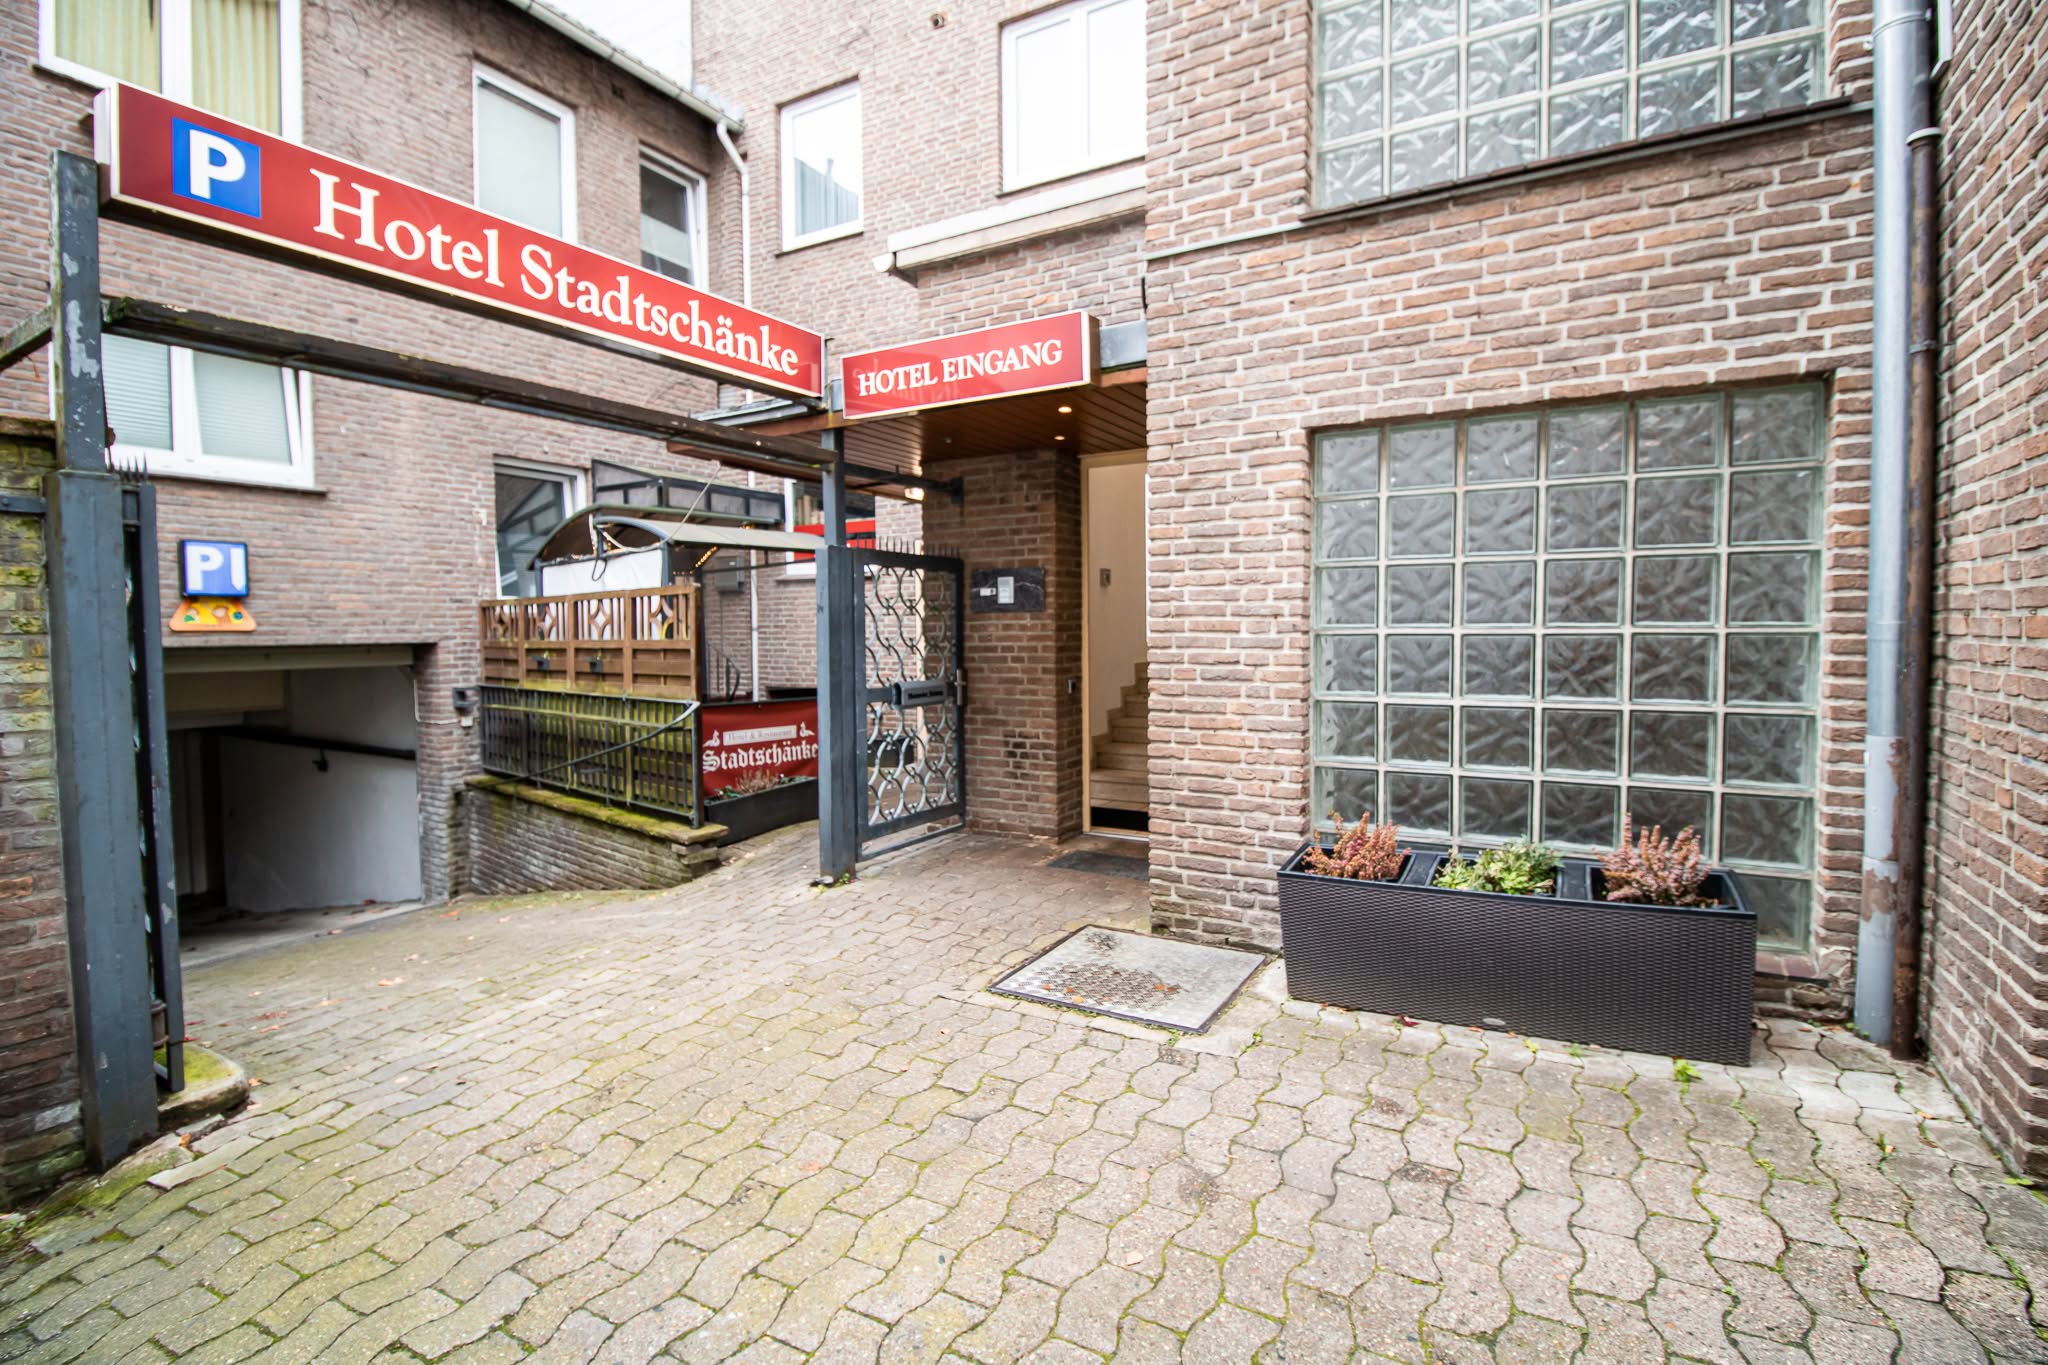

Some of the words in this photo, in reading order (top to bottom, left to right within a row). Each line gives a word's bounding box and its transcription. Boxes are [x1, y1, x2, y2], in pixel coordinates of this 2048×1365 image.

[189, 128, 246, 200] P
[309, 167, 505, 288] Hotel
[520, 243, 799, 376] Stadtschänke
[857, 362, 938, 396] HOTEL
[941, 339, 1063, 383] EINGANG
[702, 739, 819, 774] Stadtschänke
